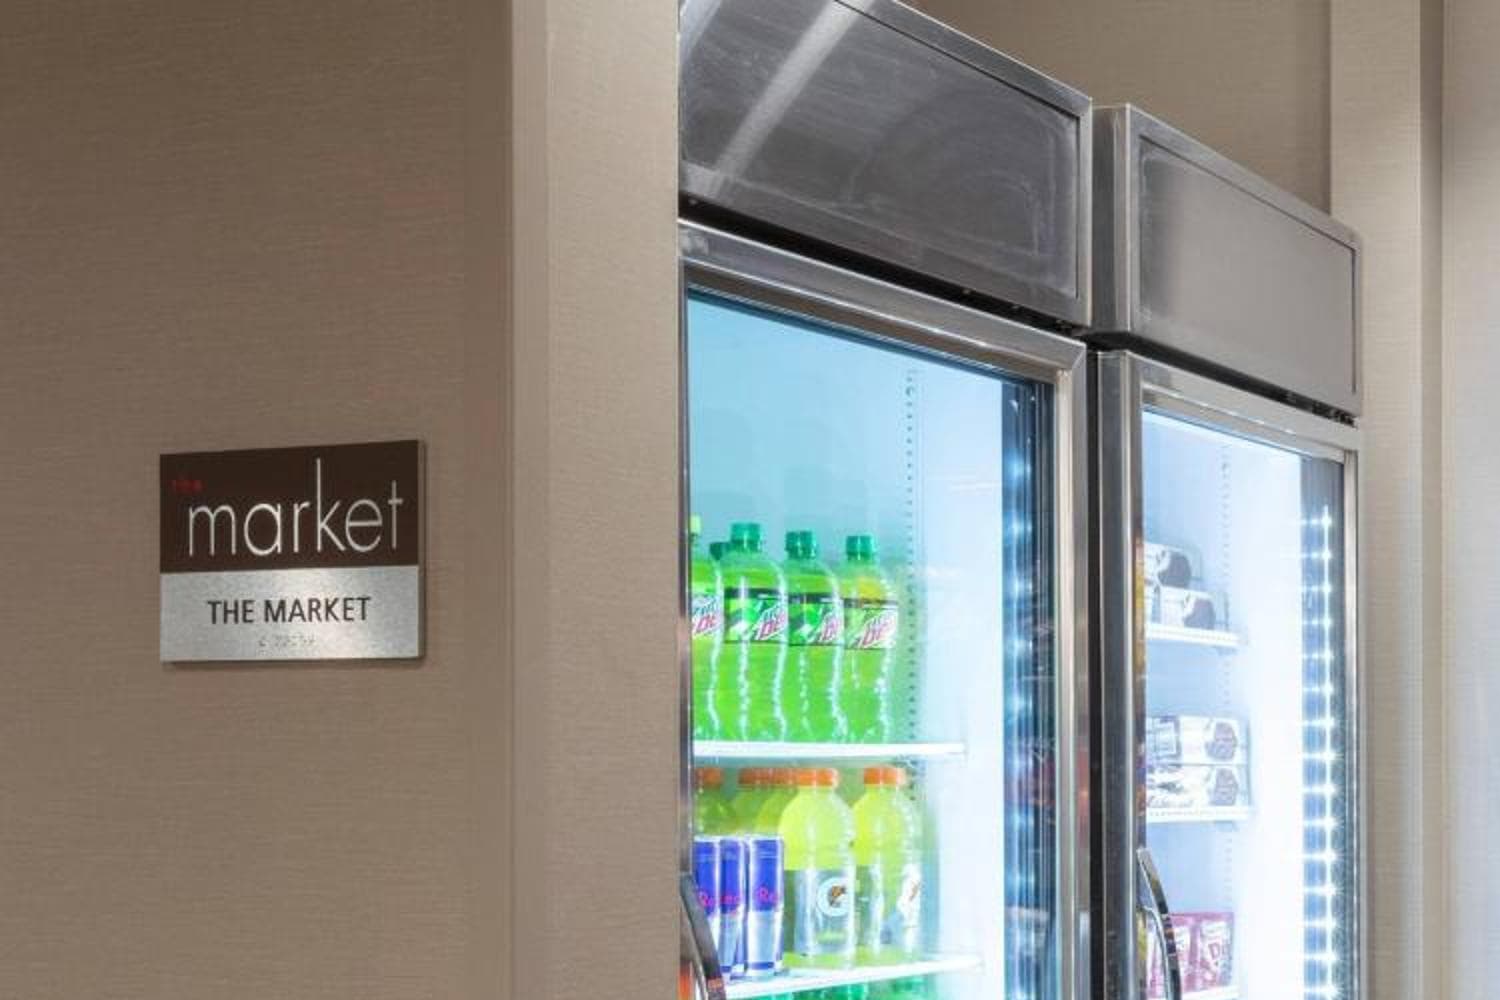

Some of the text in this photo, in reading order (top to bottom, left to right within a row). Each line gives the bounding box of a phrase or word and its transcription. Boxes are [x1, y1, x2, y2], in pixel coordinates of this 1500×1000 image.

[188, 457, 404, 556] market
[207, 596, 371, 625] THE MARKET
